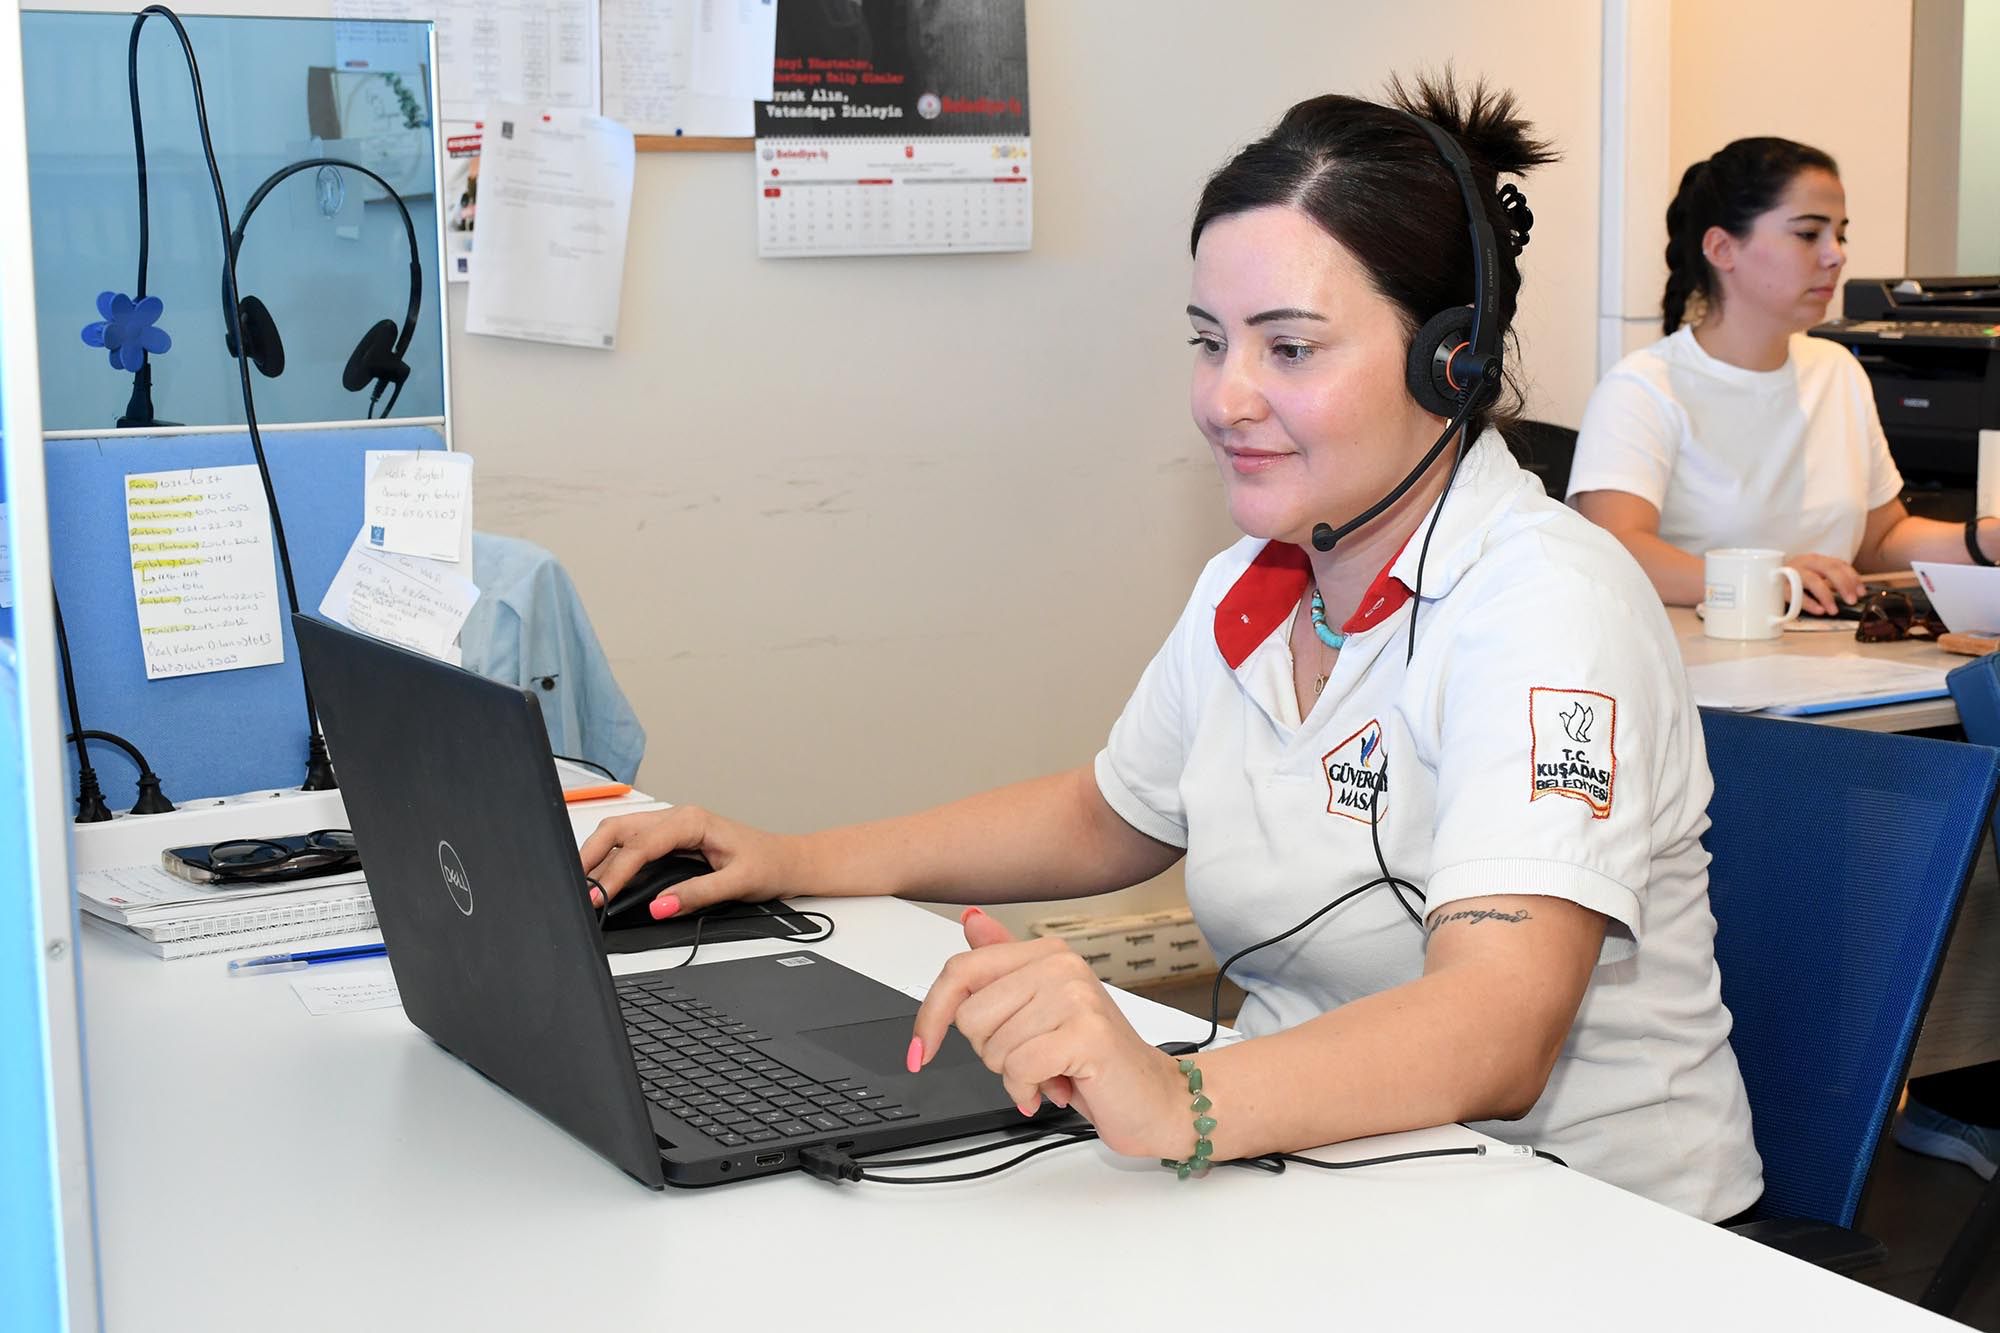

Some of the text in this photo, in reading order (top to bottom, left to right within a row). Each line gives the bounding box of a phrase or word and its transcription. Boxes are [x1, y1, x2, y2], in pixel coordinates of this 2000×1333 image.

[774, 89, 805, 102] rnek
[842, 104, 903, 120] Dinleyin
[1562, 748, 1590, 764] T.C.
[1329, 762, 1388, 792] GÜVERCN
[1537, 762, 1610, 786] KUŞADASI
[1536, 778, 1609, 803] BELEDİYESİ
[443, 864, 469, 892] DELL
